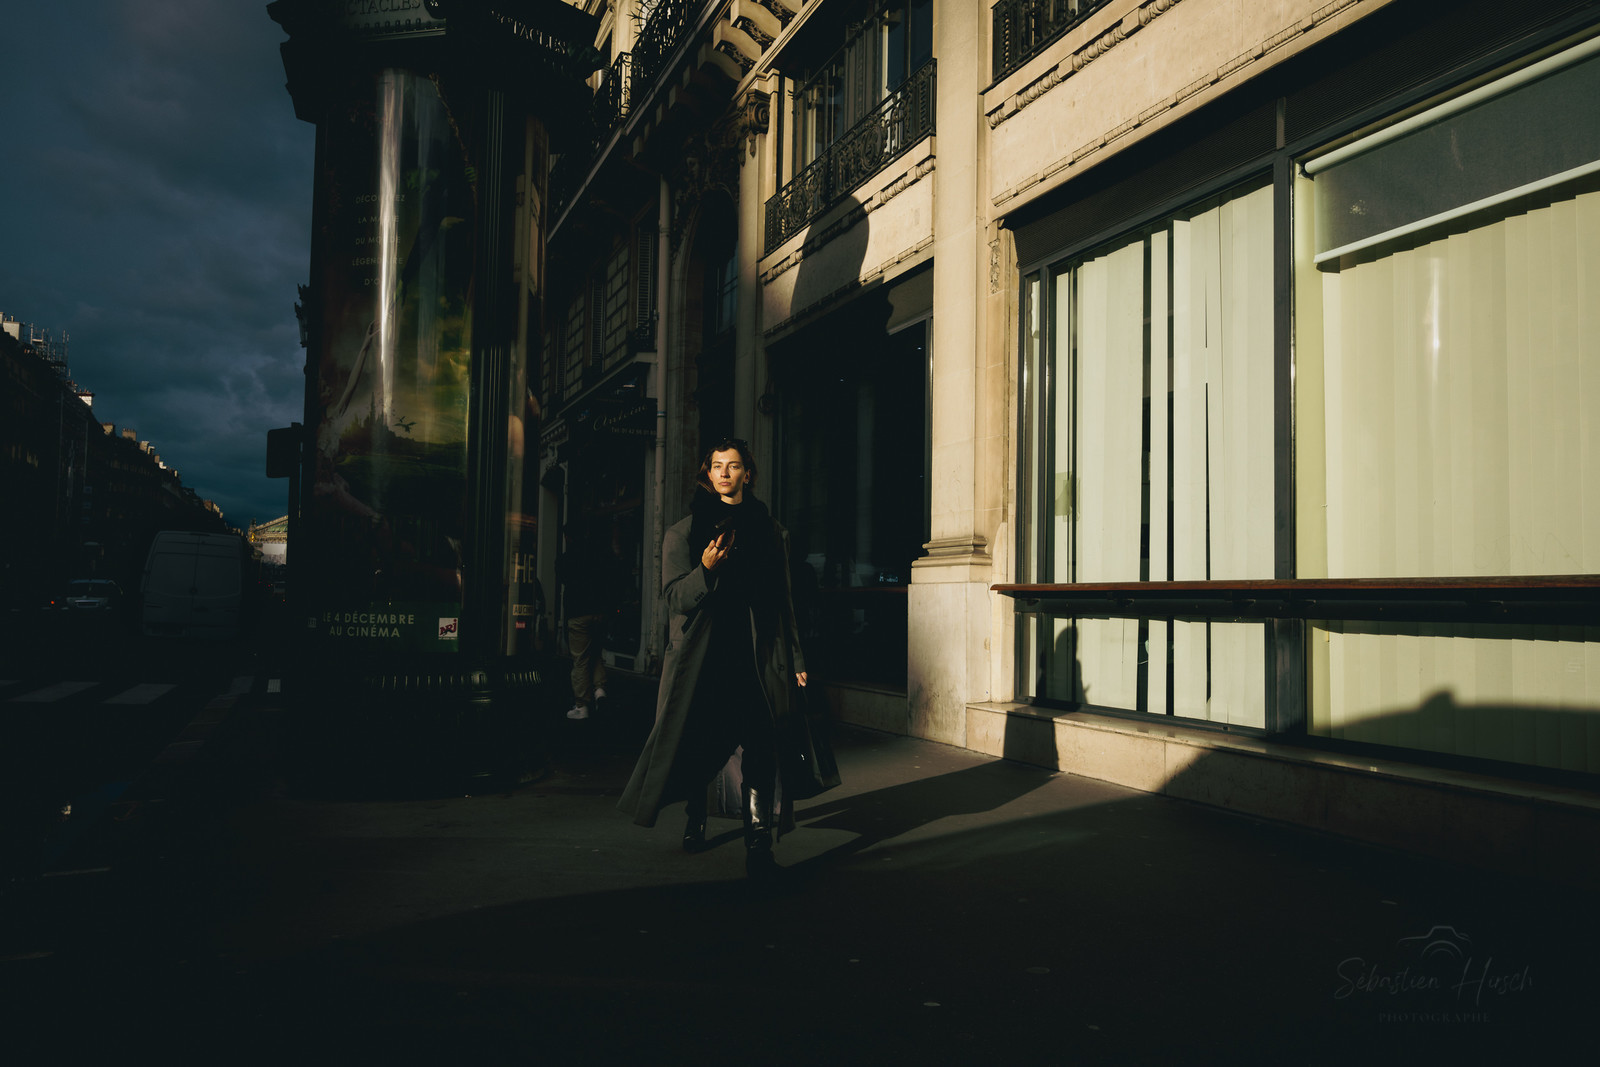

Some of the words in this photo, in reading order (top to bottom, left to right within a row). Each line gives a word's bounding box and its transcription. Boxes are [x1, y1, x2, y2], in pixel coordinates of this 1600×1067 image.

[355, 237, 366, 246] DU
[323, 611, 332, 623] LE
[334, 612, 341, 623] 4
[344, 610, 417, 625] DÉCEMBRE
[329, 626, 342, 637] AU
[346, 624, 401, 638] CINÉMA
